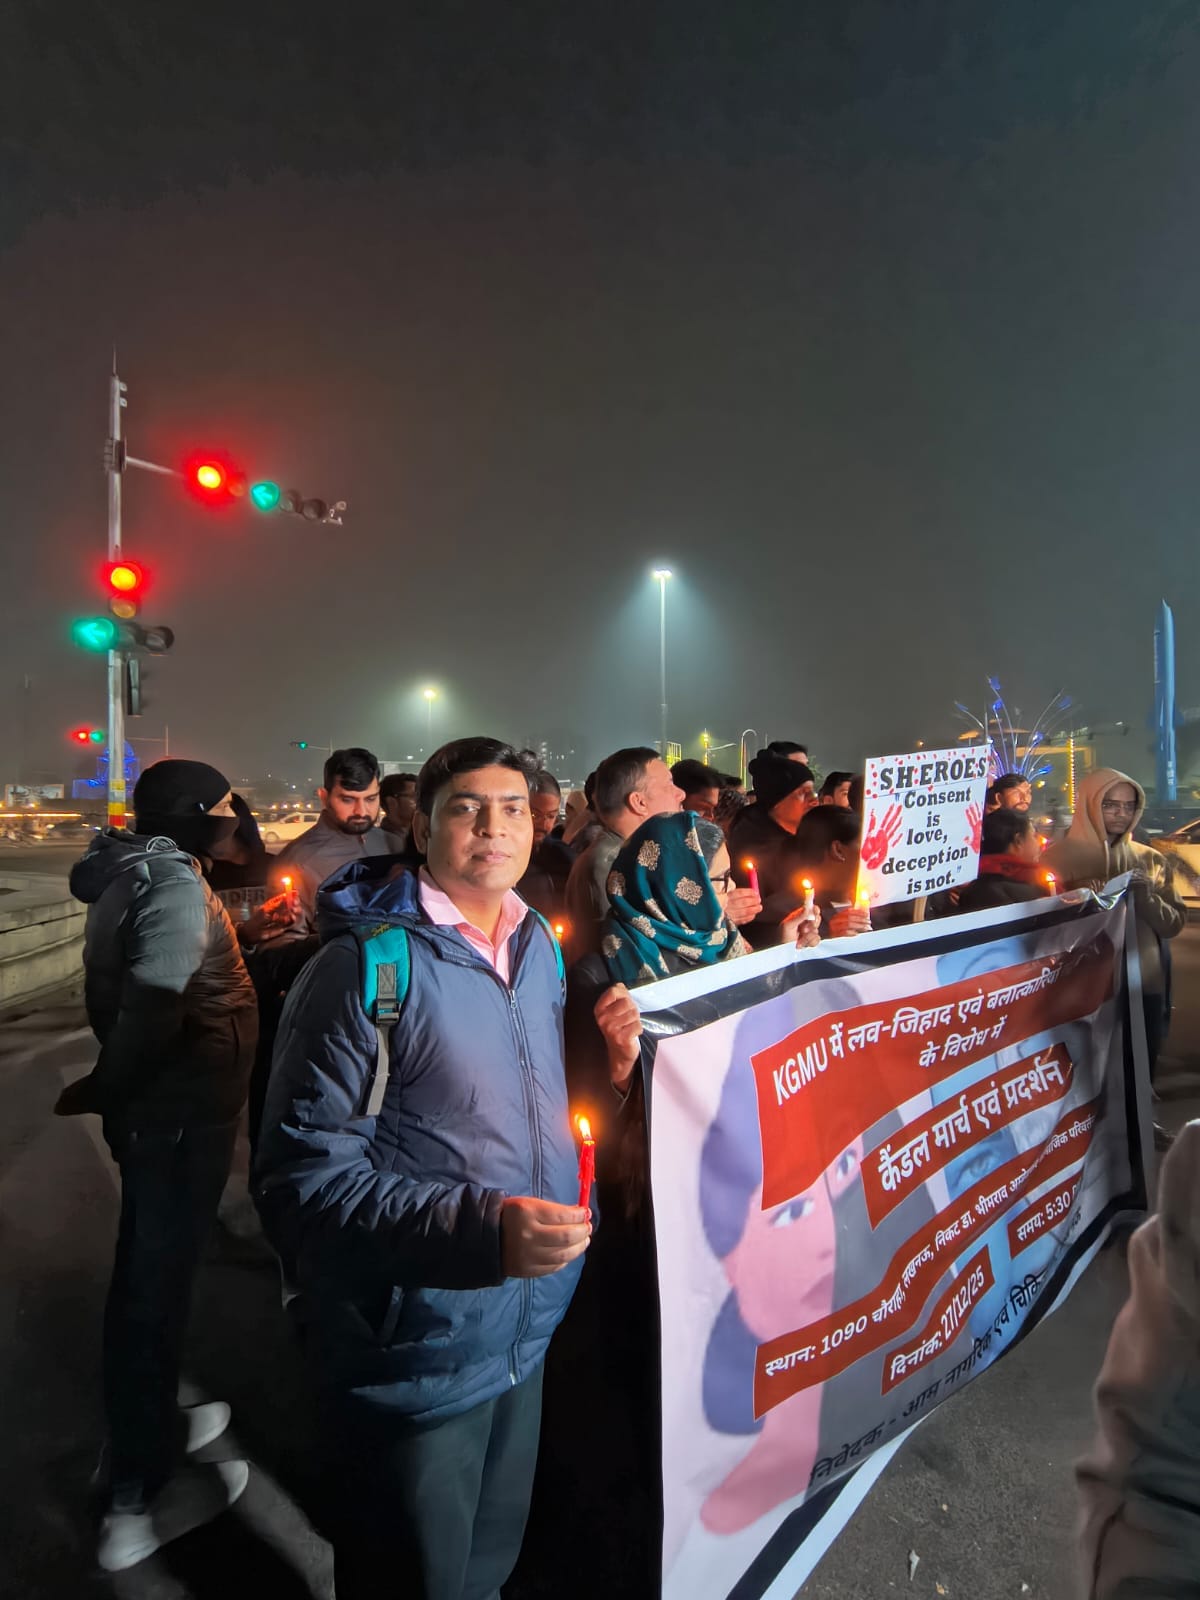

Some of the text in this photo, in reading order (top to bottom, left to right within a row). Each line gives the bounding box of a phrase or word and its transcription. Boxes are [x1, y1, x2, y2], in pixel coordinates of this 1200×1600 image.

[880, 757, 987, 791] SHEROES
[906, 828, 948, 846] love,
[926, 811, 940, 828] is
[881, 846, 969, 875] deception
[907, 878, 922, 895] is
[772, 1037, 828, 1106] KGMU
[829, 1021, 845, 1059] में
[848, 1006, 955, 1052] लव-जिहाद
[957, 988, 984, 1024] एवं
[918, 1014, 1008, 1068] के विरोध में
[878, 1055, 1065, 1192] कैंडल मार्च एवं प्रदर्शन
[1016, 1212, 1045, 1242] समय:
[1045, 1191, 1071, 1220] 5:30
[765, 1345, 817, 1377] स्थान:
[820, 1315, 868, 1355] 1090
[935, 1219, 961, 1252] निकट
[960, 1210, 976, 1230] डा.
[975, 1184, 1009, 1216] भीमराव
[890, 1265, 985, 1381] दिनांक: 27/12/25
[809, 1420, 886, 1487] निवेदक
[902, 1379, 943, 1418] आम
[945, 1325, 993, 1385] नागरिक
